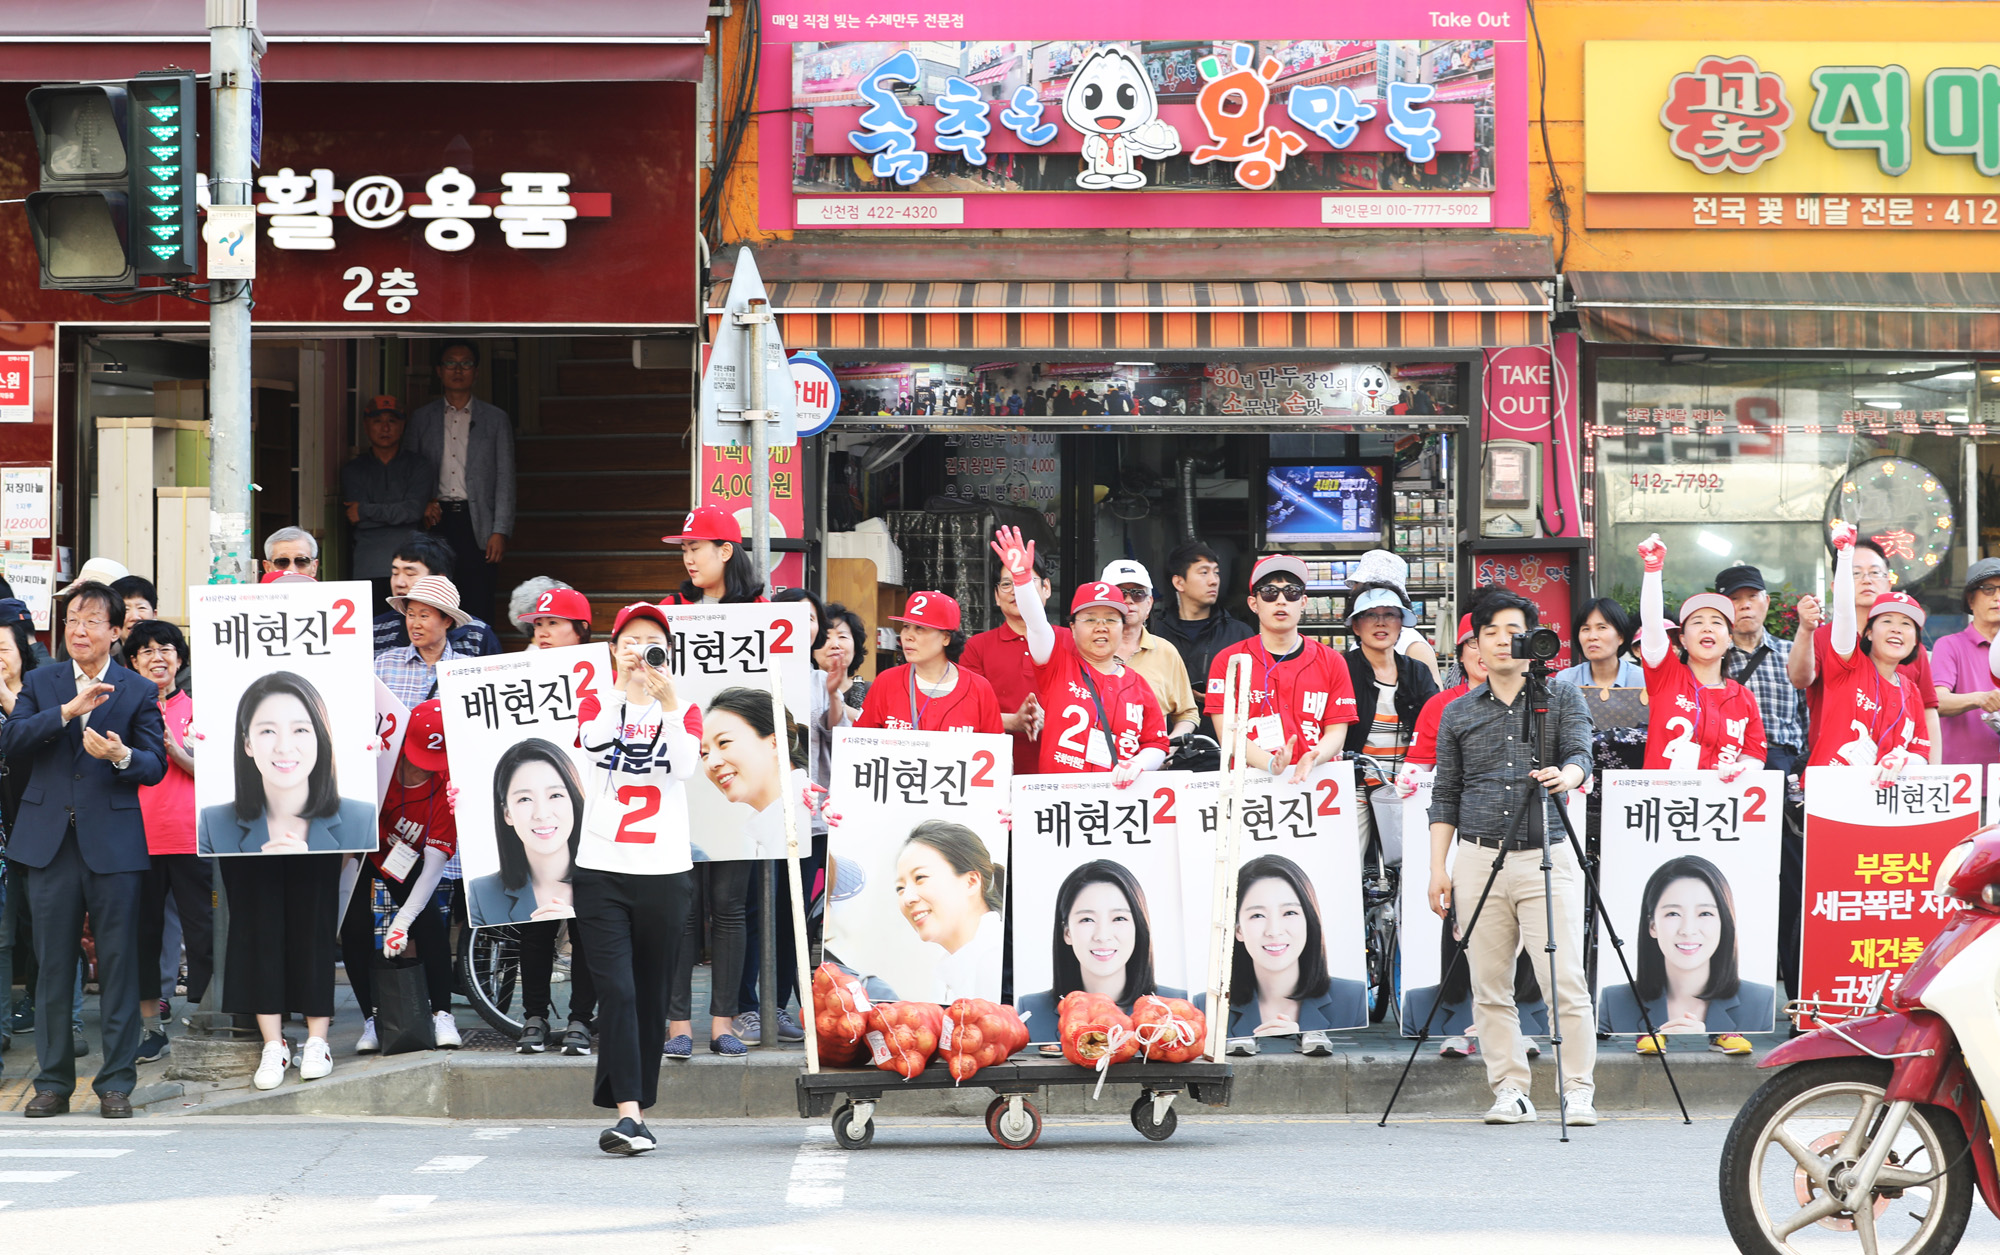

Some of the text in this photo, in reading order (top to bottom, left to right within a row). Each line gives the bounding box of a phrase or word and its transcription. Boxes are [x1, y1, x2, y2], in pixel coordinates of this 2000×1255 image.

[772, 14, 799, 29] 매일
[802, 14, 829, 29] 직접
[865, 14, 919, 28] 수제만두
[923, 14, 964, 29] 전문점
[1429, 12, 1511, 28] Take Out
[821, 205, 938, 220] 신천점 422-4320
[1331, 204, 1479, 219] 체인문의 010-7777-5902
[1693, 197, 1746, 225] 전국
[1758, 197, 1784, 225] 꽃
[1796, 197, 1851, 225] 배달
[1861, 197, 1914, 225] 전문
[1944, 199, 1998, 225] 412
[342, 265, 419, 315] 2층
[1214, 365, 1349, 391] 30년 만두 장인의
[1498, 365, 1551, 385] TAKE
[1222, 390, 1324, 416] 소문난 손맛
[1499, 396, 1551, 415] OUT
[1626, 408, 1651, 422] 전국
[1893, 410, 1916, 423] 화환
[945, 457, 1007, 476] 김치왕만두
[1031, 458, 1056, 473] 4,000
[1031, 486, 1055, 501] 4,000
[1630, 473, 1719, 488] 412-7792
[4, 517, 48, 529] 12800
[683, 512, 695, 532] 2
[1007, 548, 1025, 574] 2
[538, 592, 553, 612] 2
[1094, 583, 1110, 601] 2
[910, 595, 928, 616] 2
[212, 598, 356, 660] 배현진 2
[769, 618, 794, 654] 2
[461, 660, 598, 730] 배현진 2
[427, 732, 444, 750] 2
[1057, 704, 1090, 754] 2
[853, 749, 995, 806] 배현진 2
[1316, 778, 1341, 817] 2
[1876, 773, 1972, 815] 배현진 2
[614, 784, 662, 844] 2
[1034, 787, 1177, 848] 배현진 2
[1624, 786, 1767, 843] 배현진 2
[1854, 852, 1932, 884] 부동산
[1811, 889, 1916, 922] 세금폭탄
[1849, 936, 1925, 969] 재건축
